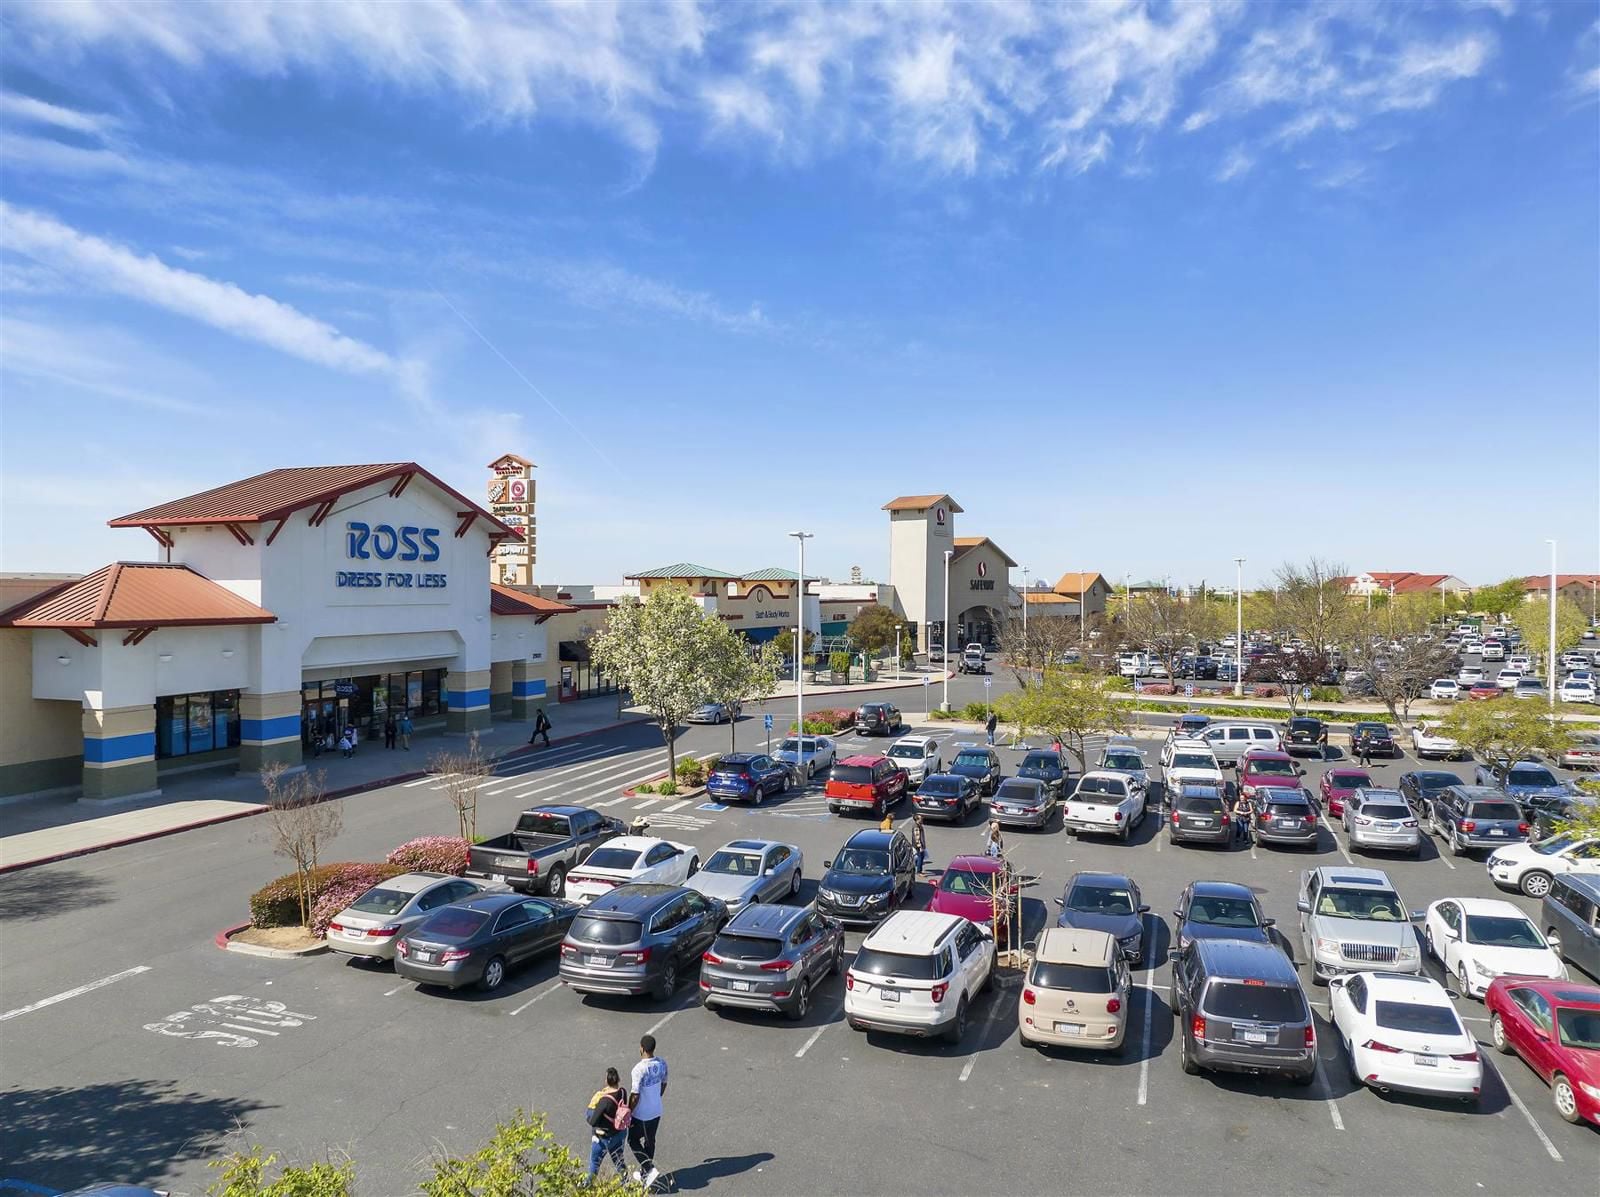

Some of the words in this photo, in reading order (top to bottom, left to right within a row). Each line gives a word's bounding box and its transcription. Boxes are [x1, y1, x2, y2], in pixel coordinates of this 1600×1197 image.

[346, 522, 440, 562] ROSS
[336, 572, 382, 588] DRESS
[385, 572, 413, 588] FOR
[416, 573, 447, 589] LESS
